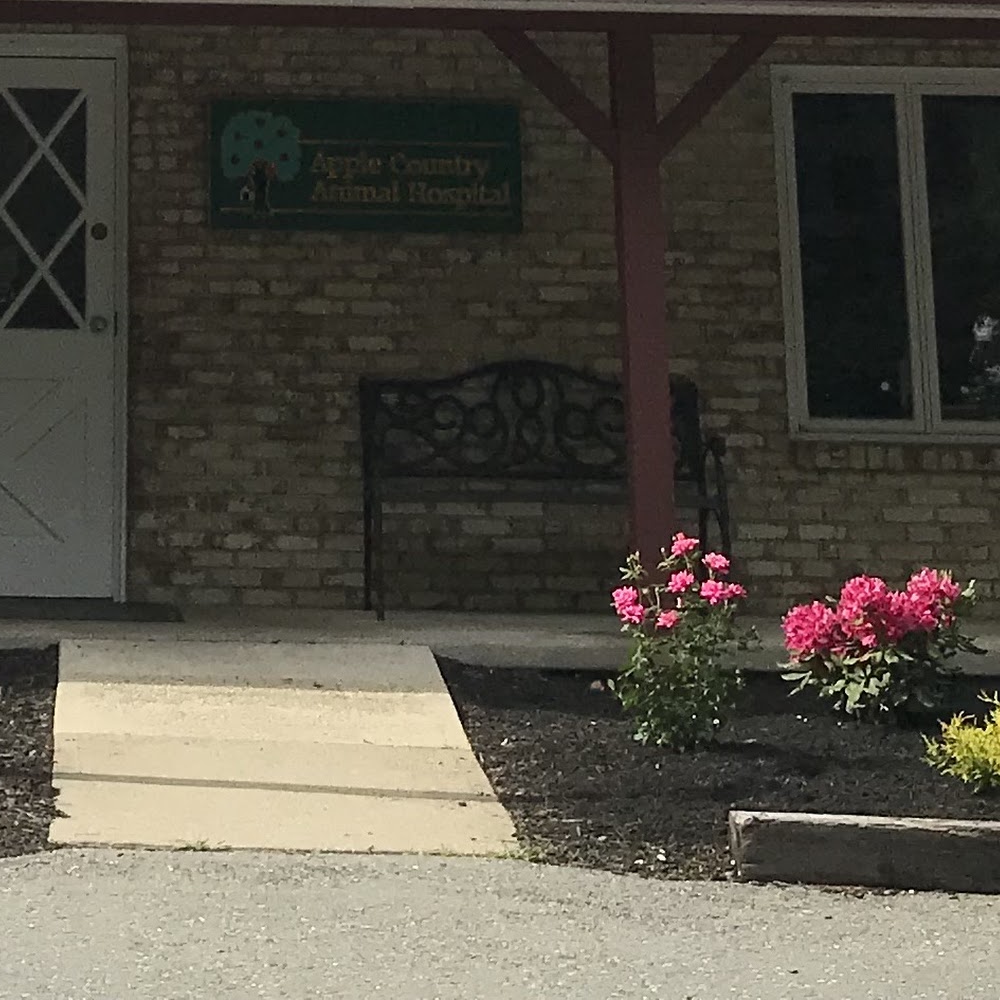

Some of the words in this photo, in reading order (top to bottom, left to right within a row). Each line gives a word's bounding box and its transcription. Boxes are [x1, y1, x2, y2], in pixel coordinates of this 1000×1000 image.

[310, 152, 382, 179] Apple
[389, 152, 490, 181] Country
[311, 180, 400, 203] Animal
[408, 181, 510, 209] Hospital
